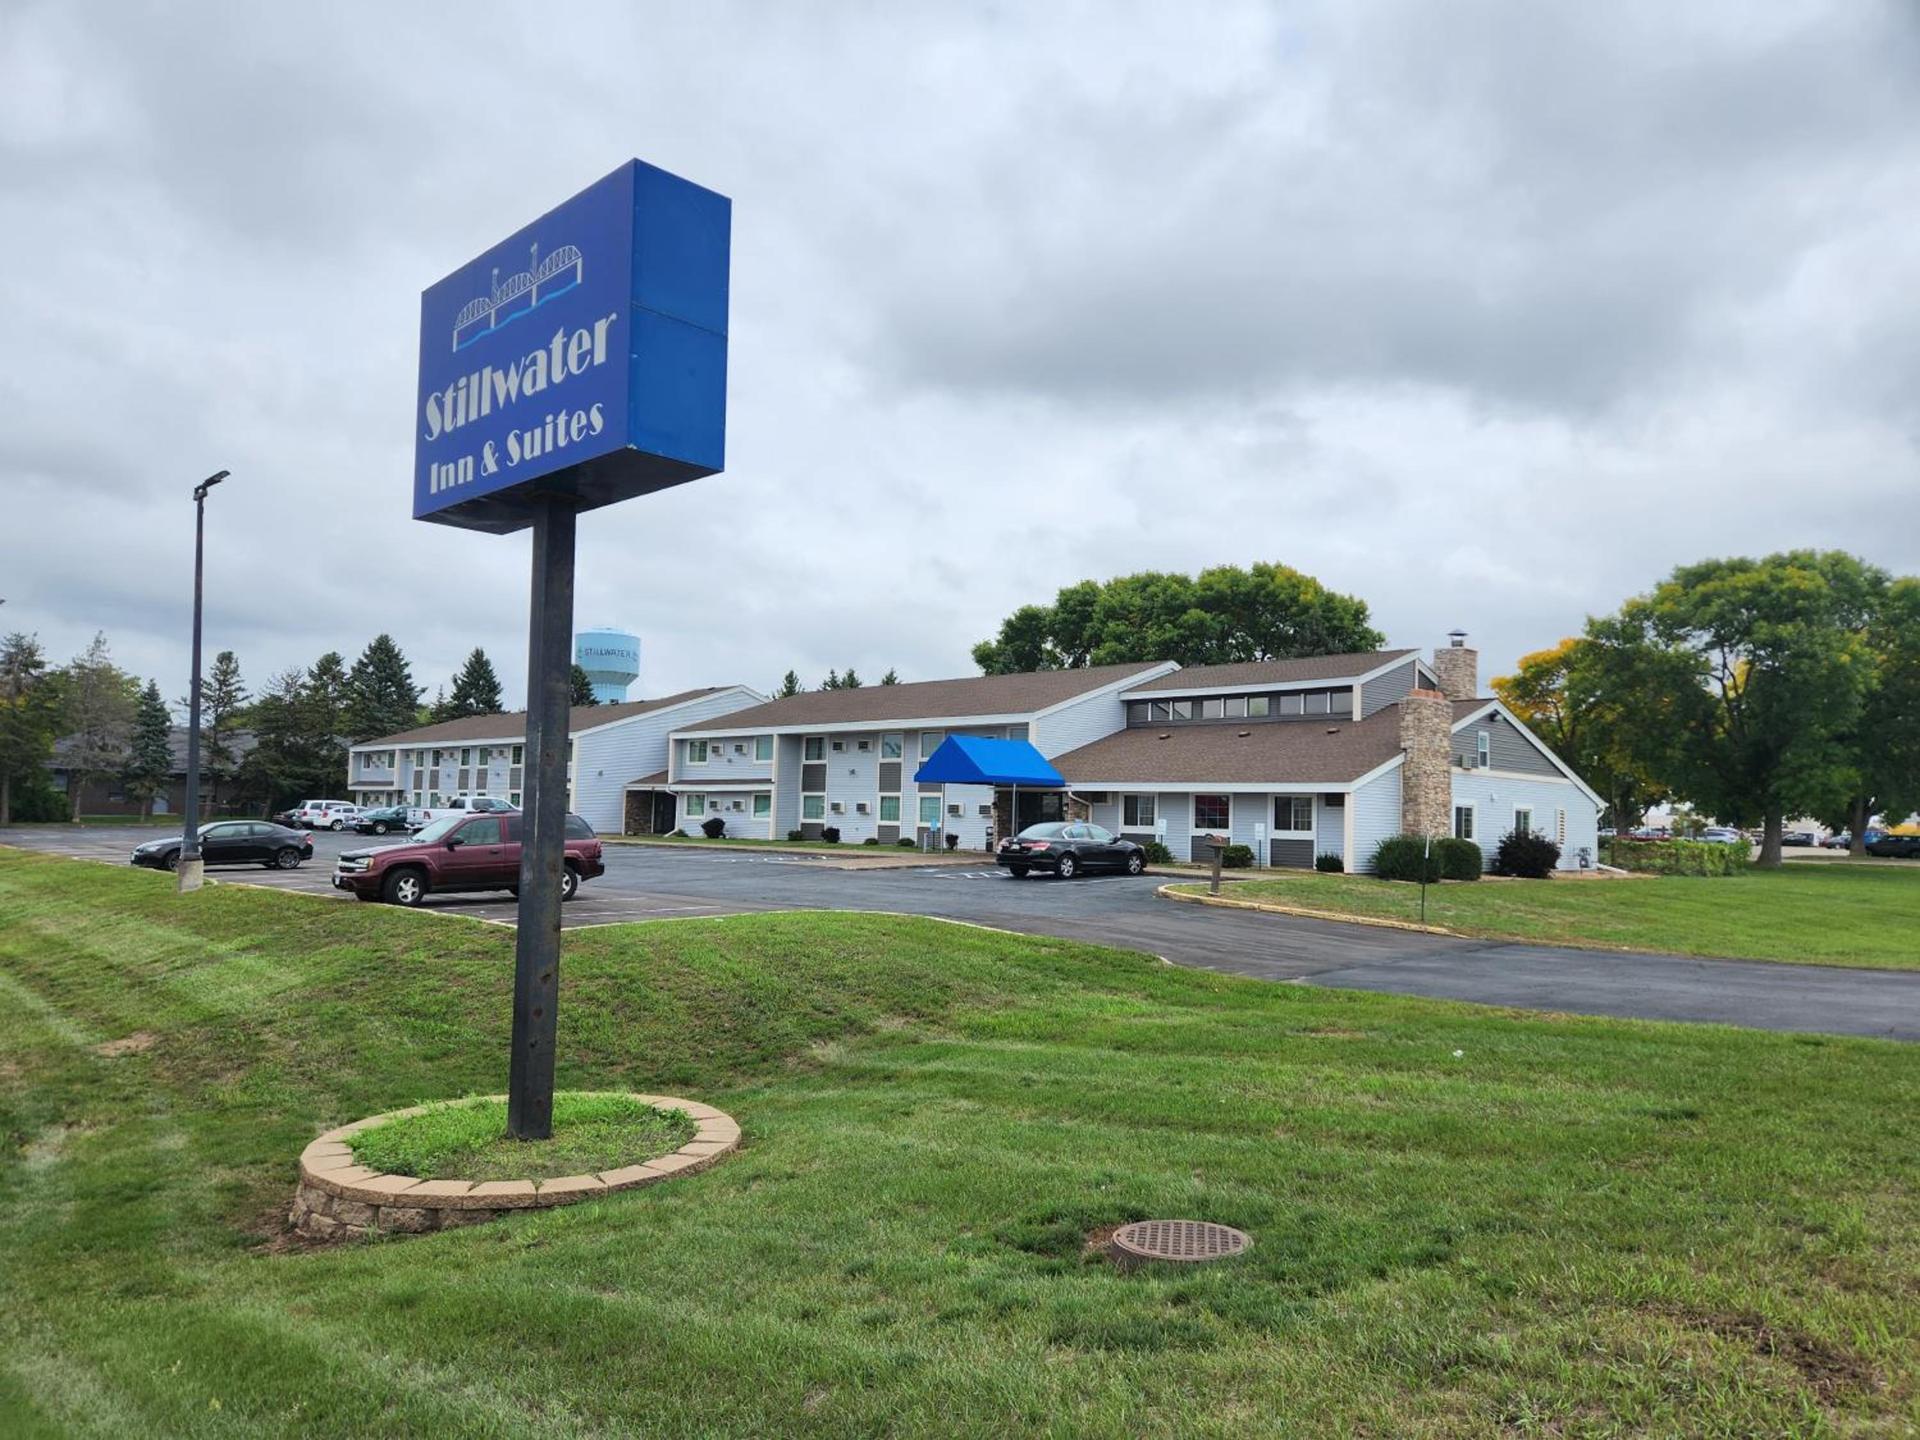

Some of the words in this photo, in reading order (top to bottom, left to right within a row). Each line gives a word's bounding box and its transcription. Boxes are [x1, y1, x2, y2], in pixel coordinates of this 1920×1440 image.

[425, 313, 617, 441] Stillwater
[430, 455, 474, 494] Inn
[481, 440, 499, 476] &
[506, 403, 603, 467] Suites
